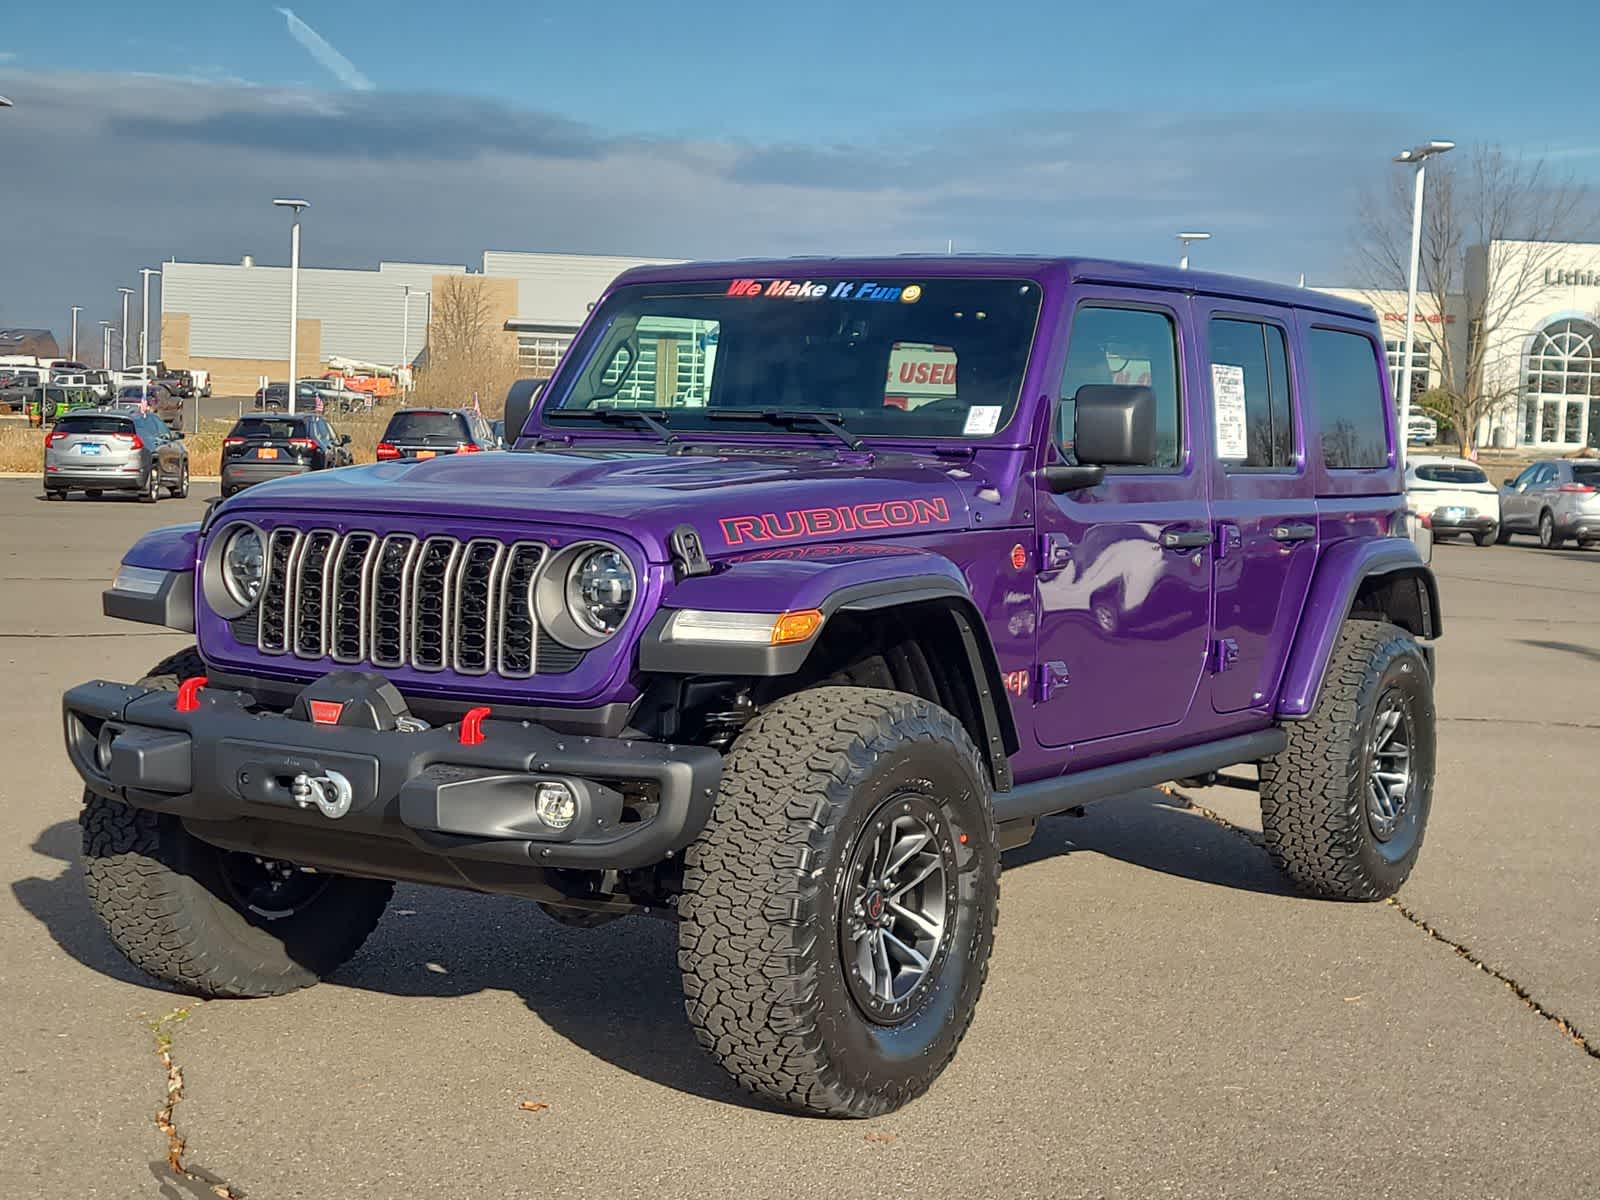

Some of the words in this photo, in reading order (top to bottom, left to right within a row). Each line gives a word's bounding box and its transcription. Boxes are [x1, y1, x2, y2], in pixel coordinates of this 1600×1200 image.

[727, 278, 762, 296] We
[764, 280, 827, 298] Make
[831, 282, 853, 297] It
[855, 282, 901, 301] Fun
[899, 362, 957, 385] USED
[719, 497, 950, 545] RUBICON
[1001, 670, 1029, 696] ep
